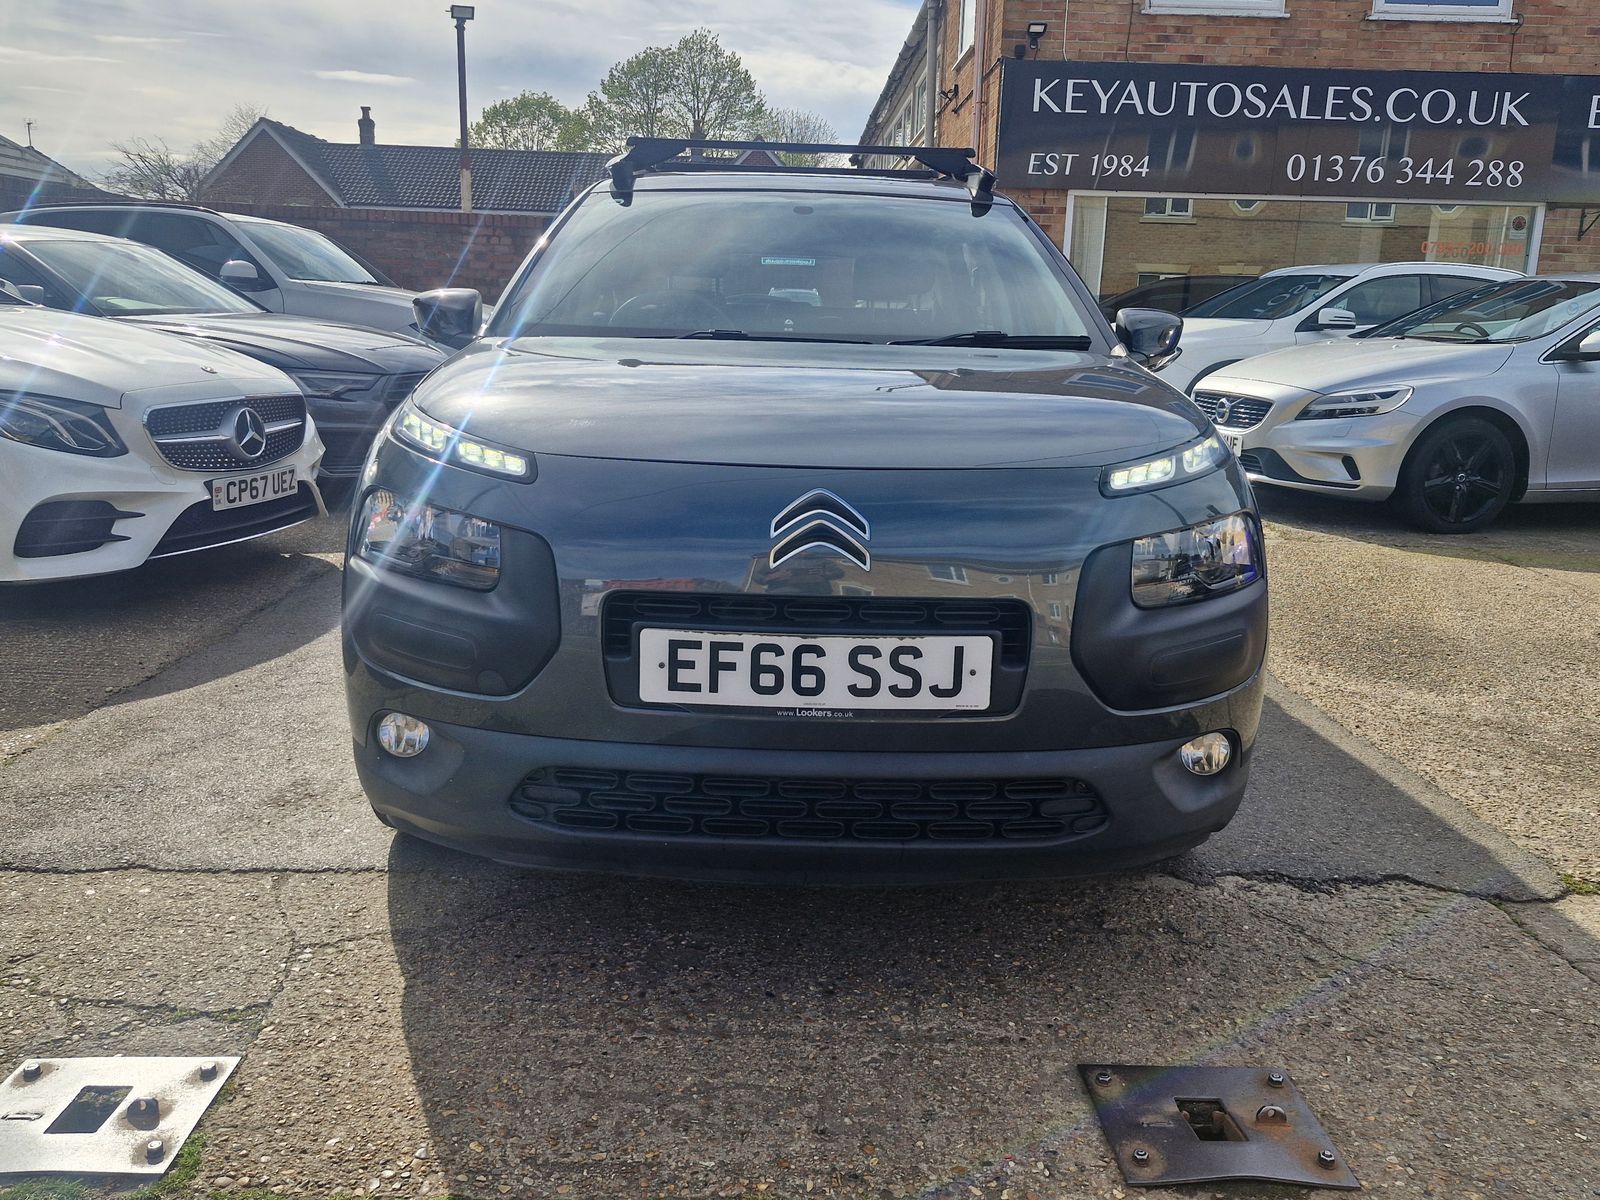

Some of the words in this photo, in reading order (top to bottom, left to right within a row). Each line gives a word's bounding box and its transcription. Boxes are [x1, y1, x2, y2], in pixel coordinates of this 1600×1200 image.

[1032, 78, 1531, 126] KEYAUTOSALES.CO.UK
[1027, 153, 1080, 176] EST
[1091, 154, 1150, 177] 1984
[1286, 153, 1386, 184] 01376
[1396, 157, 1455, 185] 344
[1464, 159, 1525, 187] 288
[226, 475, 269, 504] CP67
[272, 469, 296, 495] UEZ
[667, 639, 827, 696] EF66
[847, 645, 964, 697] SSJ
[776, 708, 854, 718] www.Lookers.co.uk
